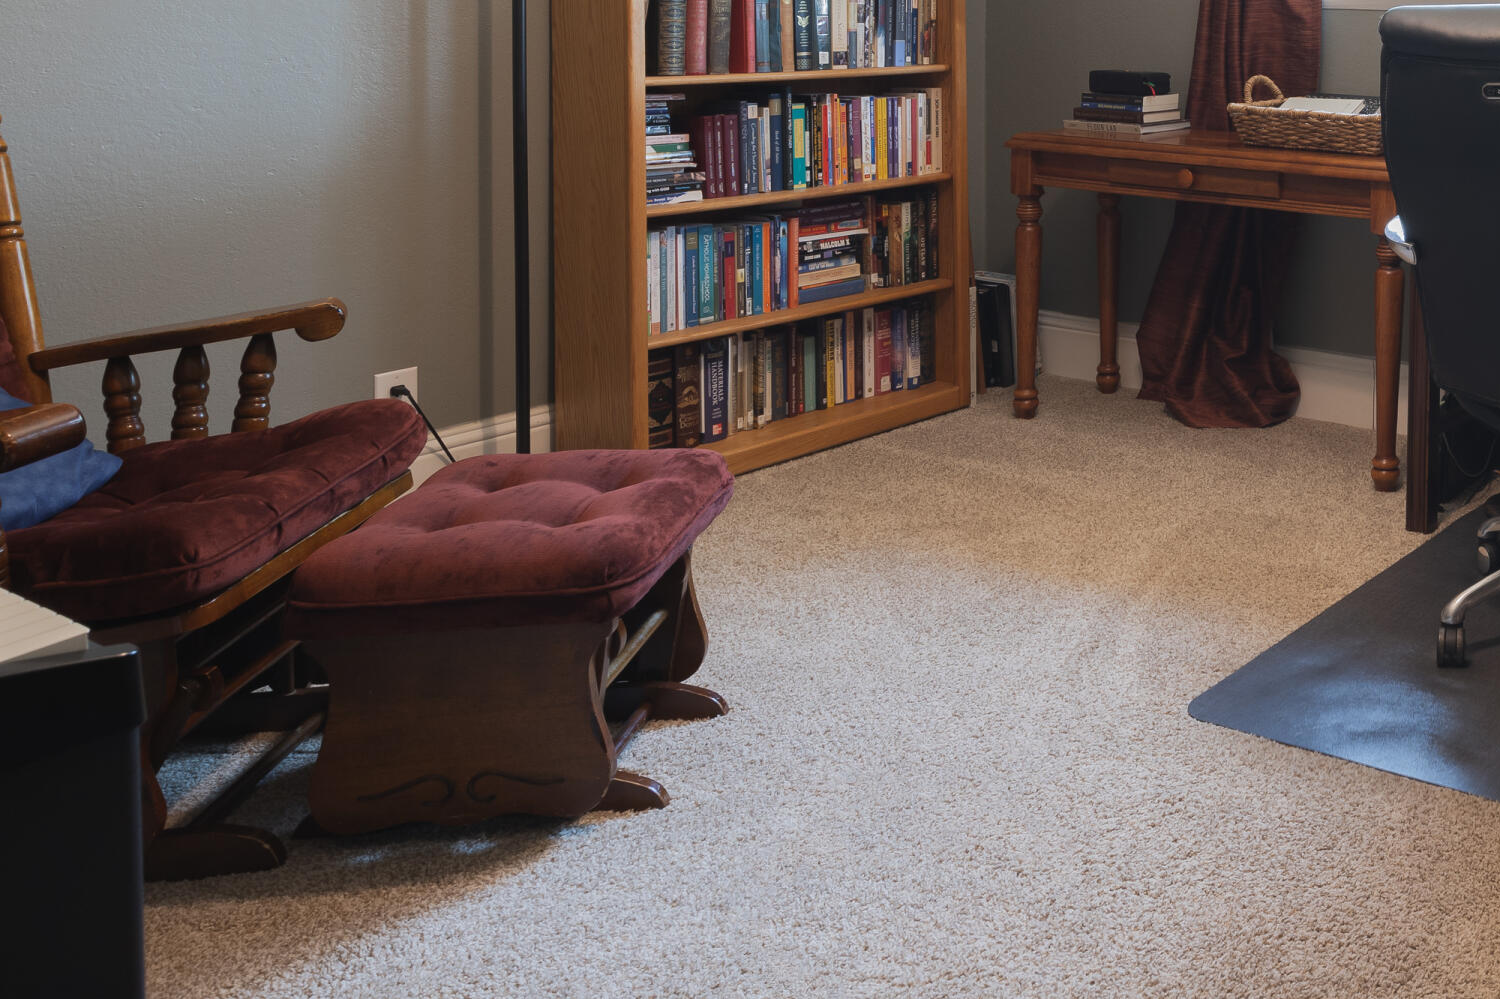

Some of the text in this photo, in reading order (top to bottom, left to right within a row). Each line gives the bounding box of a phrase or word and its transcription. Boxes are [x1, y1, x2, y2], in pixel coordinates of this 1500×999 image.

[820, 238, 851, 250] MALCOLM X
[703, 234, 711, 304] CATHOLIC HOMESCHOOL
